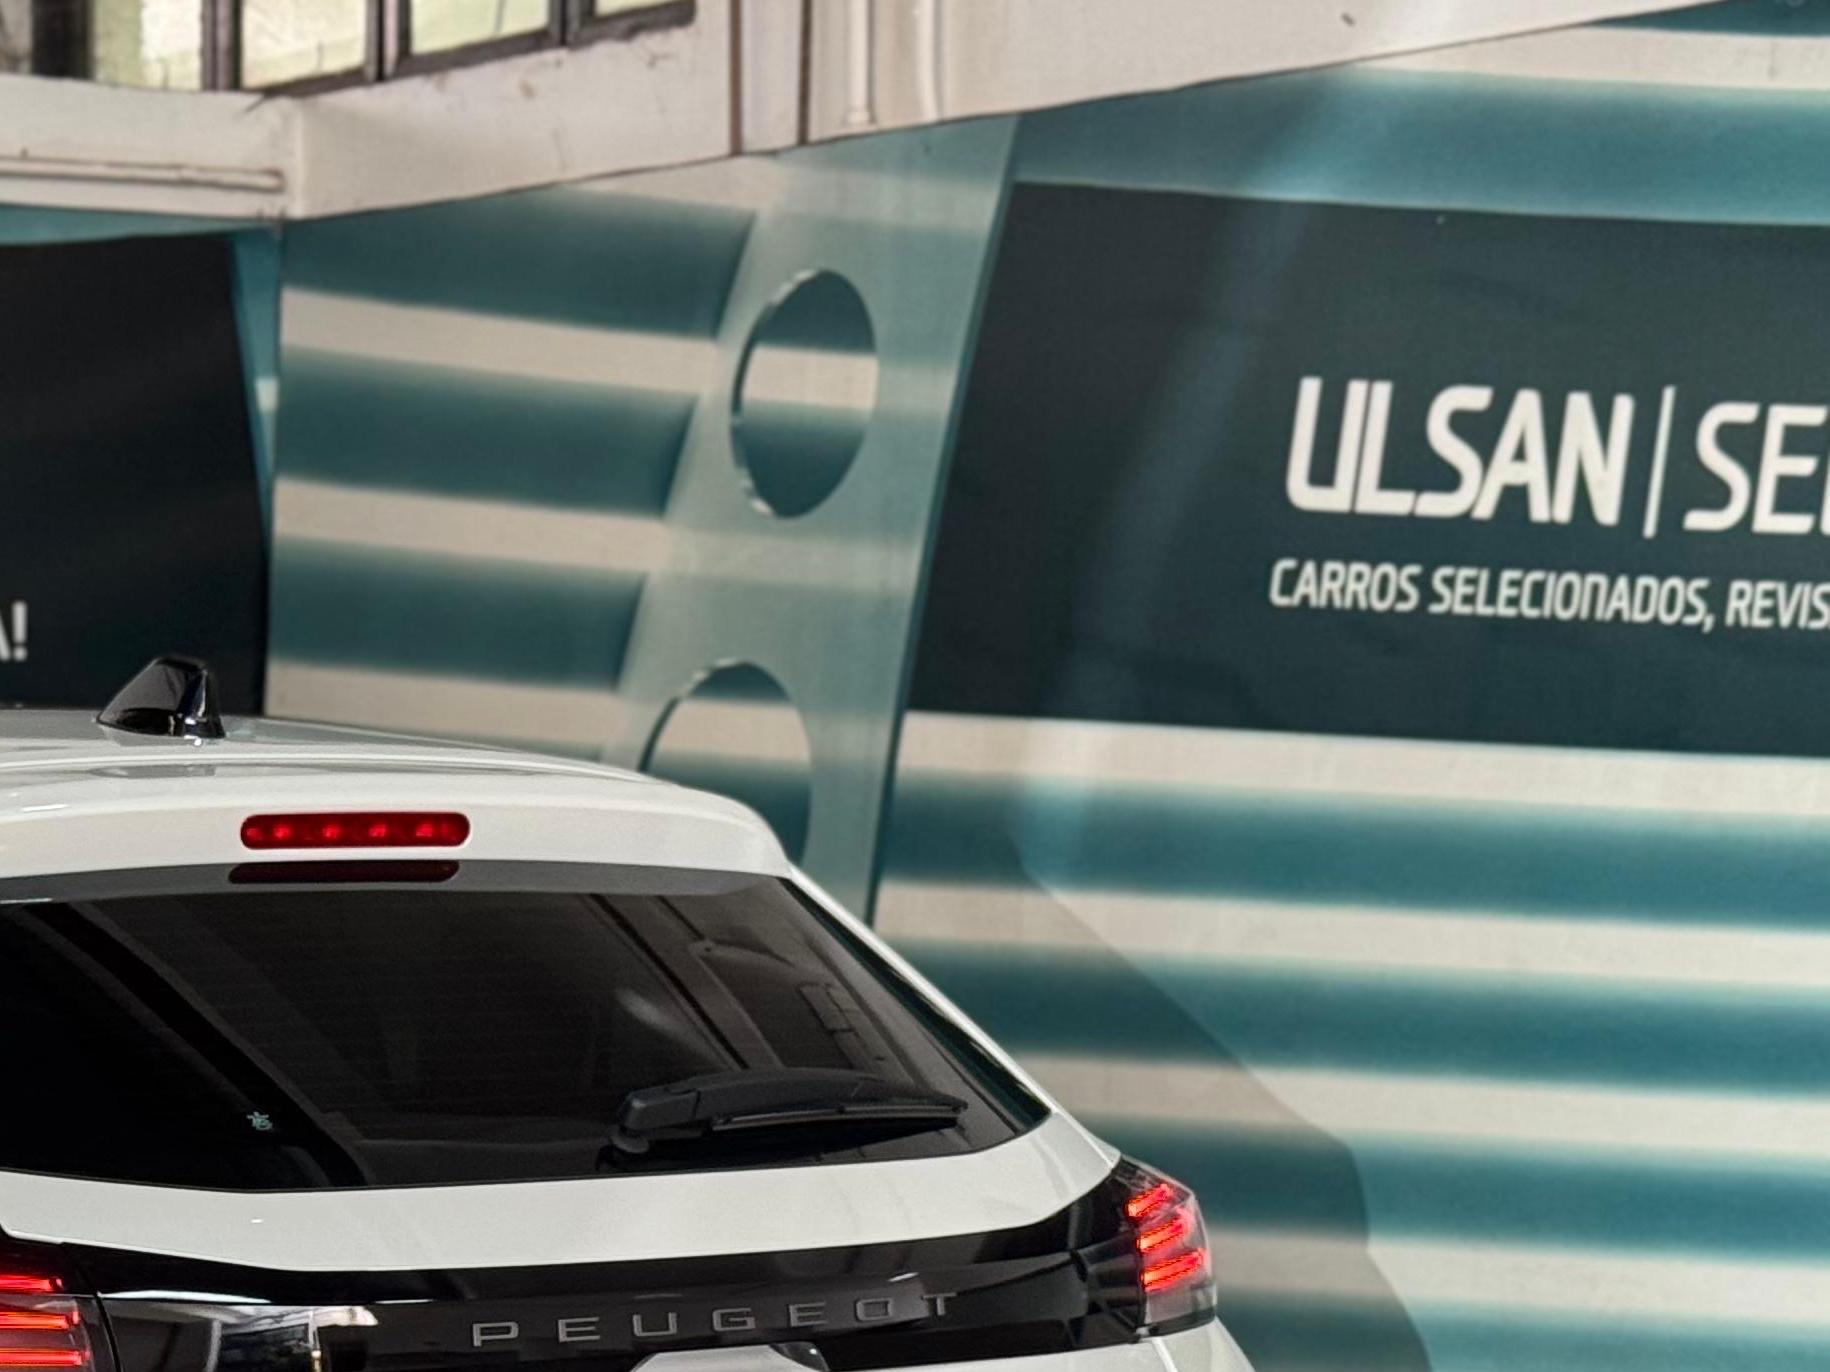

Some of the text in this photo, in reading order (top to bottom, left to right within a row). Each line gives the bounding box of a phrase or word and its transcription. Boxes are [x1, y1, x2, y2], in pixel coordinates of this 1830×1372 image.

[1287, 377, 1830, 535] ULSAN SE
[1271, 559, 1421, 611] CARROS
[1429, 567, 1714, 632] SELECIONADOS,
[472, 1292, 957, 1348] PEUGEOT
